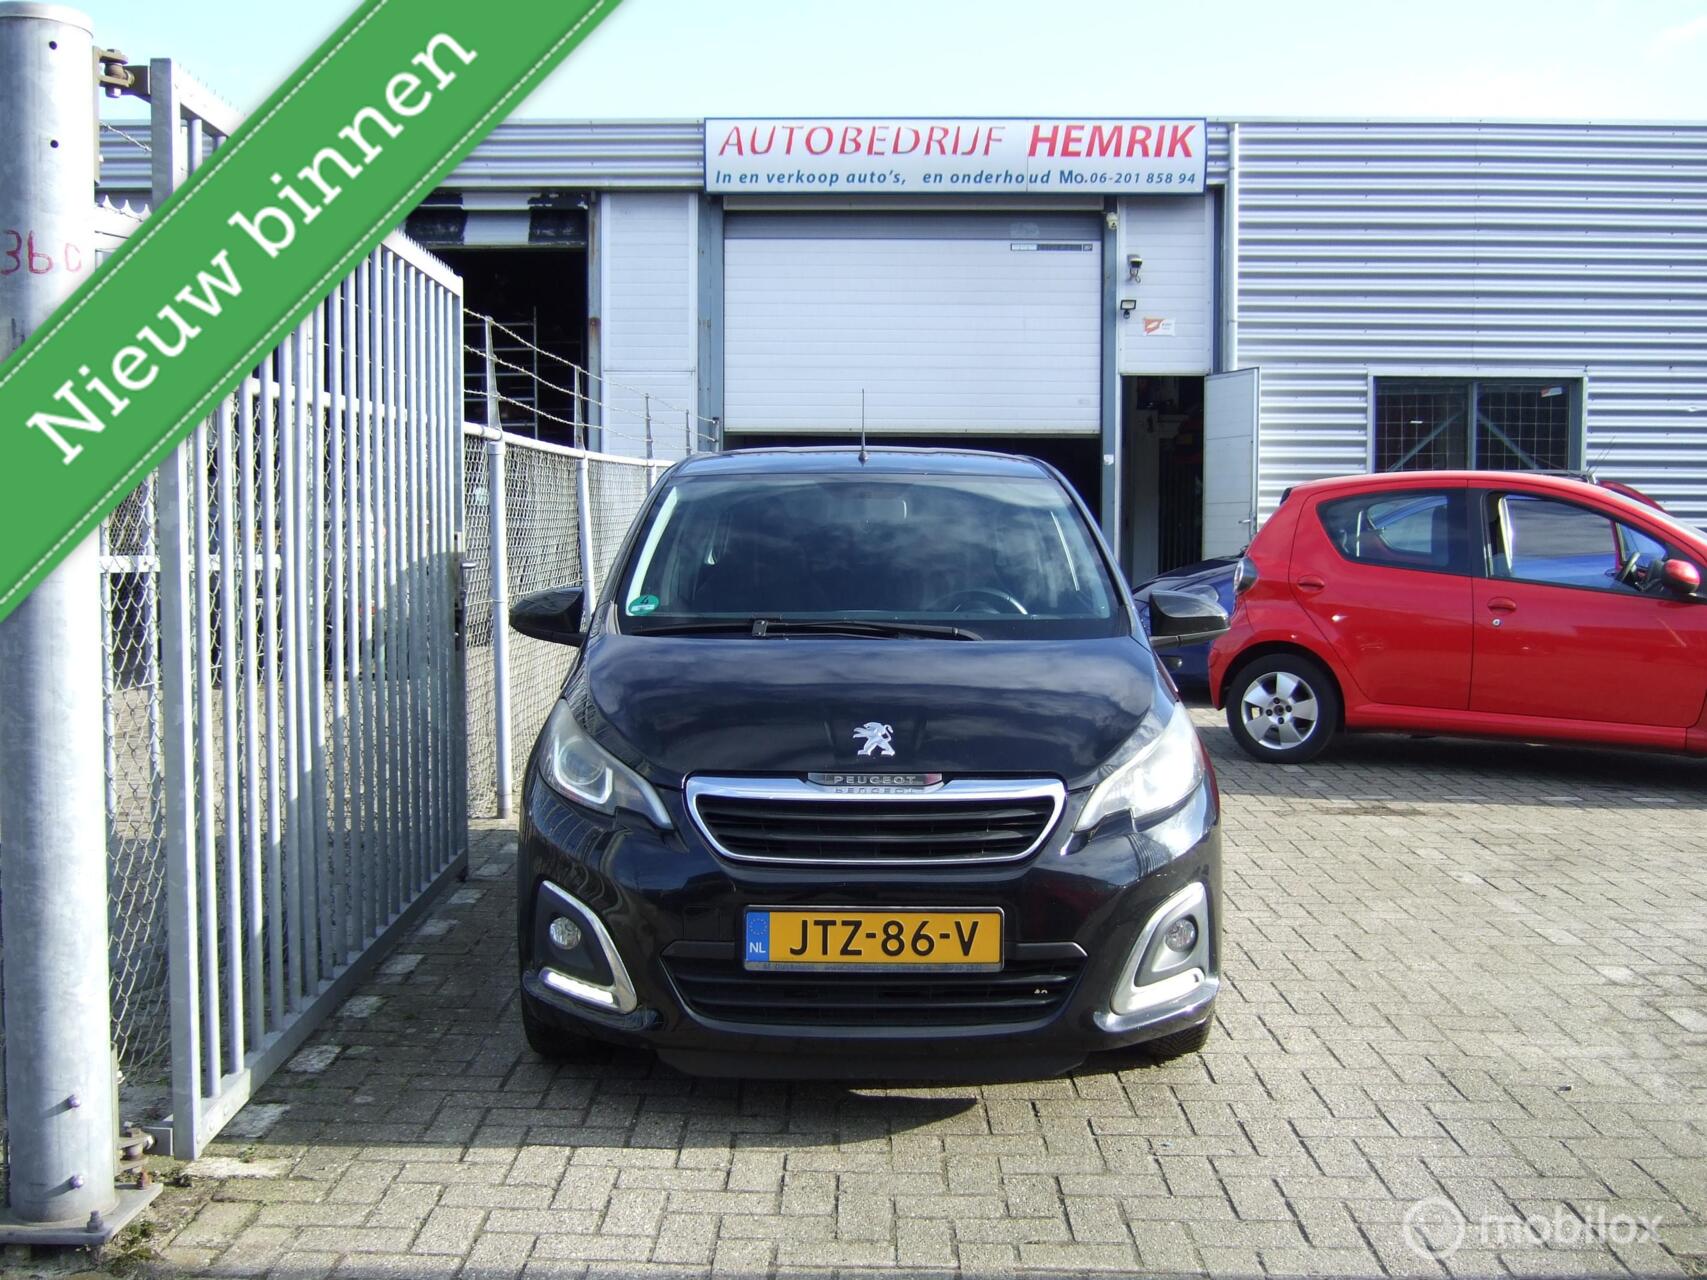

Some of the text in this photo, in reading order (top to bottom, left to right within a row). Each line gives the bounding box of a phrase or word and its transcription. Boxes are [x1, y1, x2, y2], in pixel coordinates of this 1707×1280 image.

[718, 124, 1197, 158] AUTOBEDRIJF HEMRIK
[716, 170, 732, 184] In
[739, 173, 759, 184] en
[767, 170, 839, 187] verkoop
[923, 173, 943, 184] en
[950, 170, 1051, 184] onderhoud
[1146, 172, 1173, 184] 858
[1178, 173, 1196, 184] 94
[833, 775, 916, 785] PEUGEOT
[749, 919, 980, 957] NL JTZ-86-V
